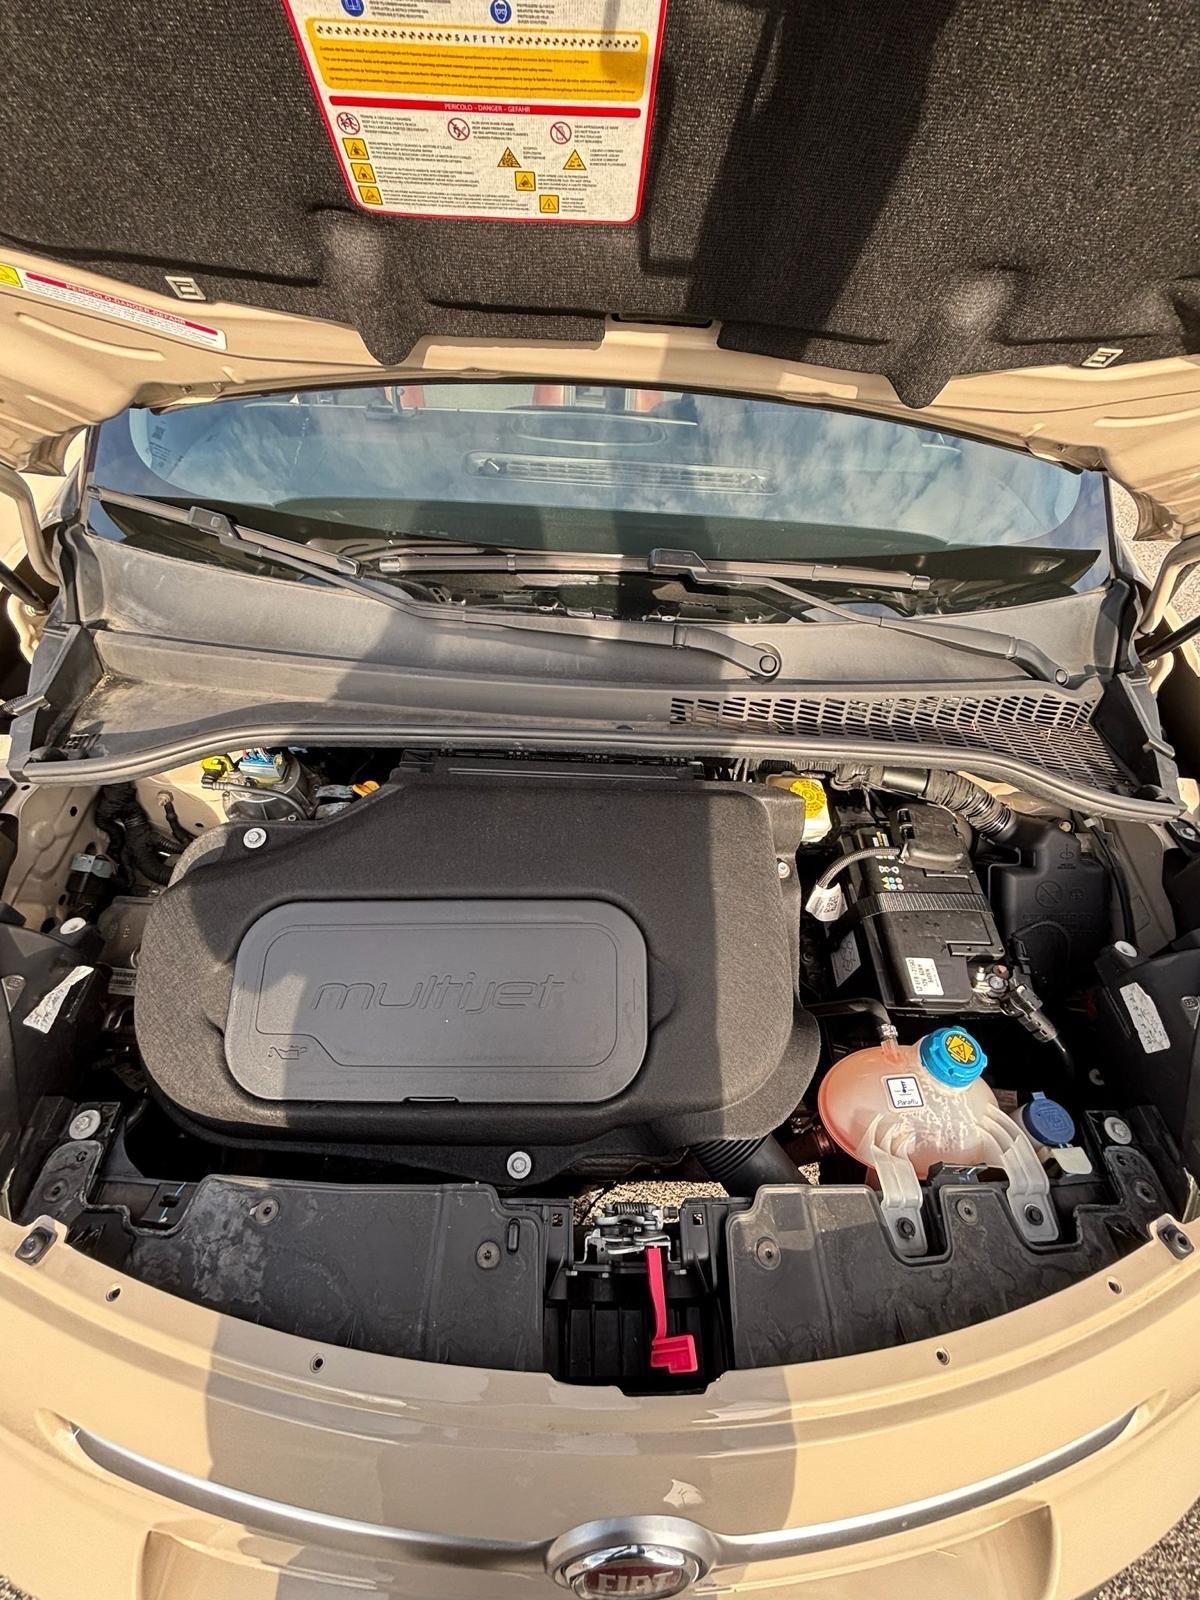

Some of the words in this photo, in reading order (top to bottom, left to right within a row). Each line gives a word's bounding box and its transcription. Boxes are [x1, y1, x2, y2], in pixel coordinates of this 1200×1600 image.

[455, 33, 505, 44] SAFETY
[444, 103, 473, 111] PERICOLO
[507, 105, 530, 113] GEFAHR
[312, 971, 565, 1015] multijet
[598, 1570, 674, 1592] FIAT
